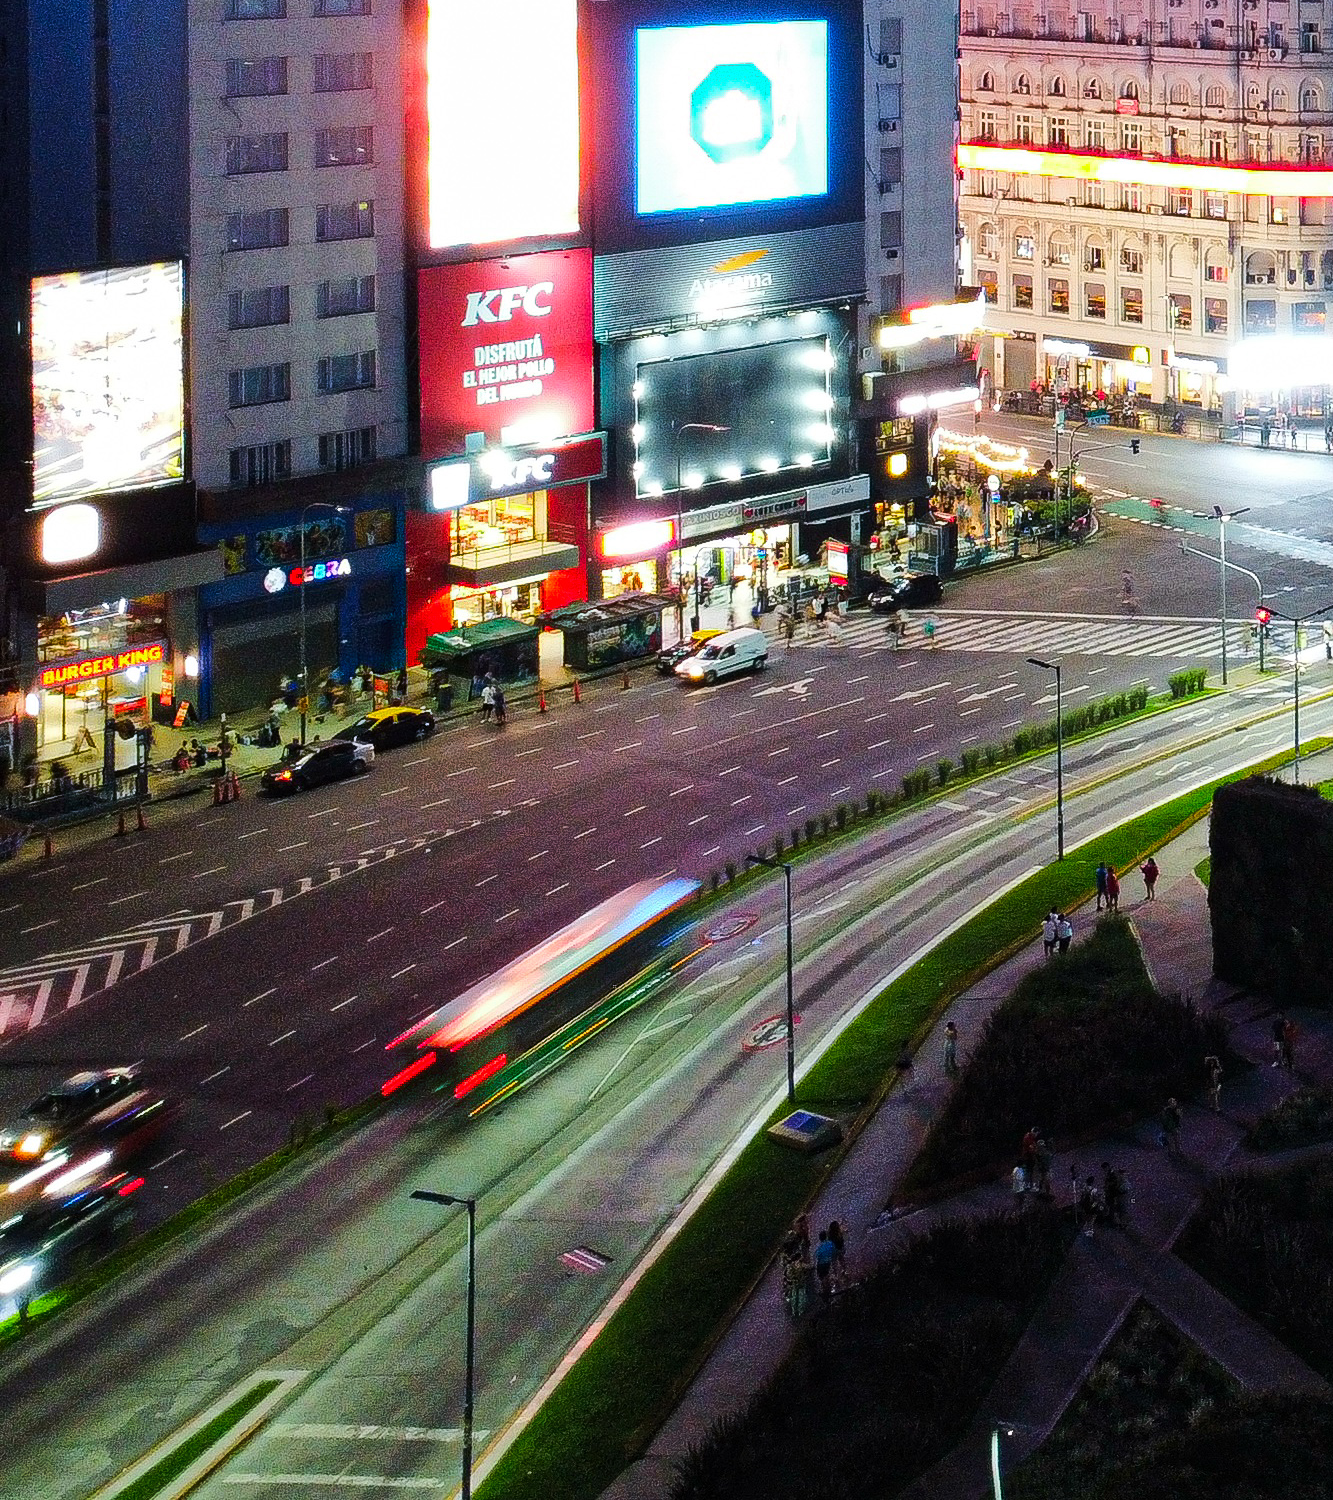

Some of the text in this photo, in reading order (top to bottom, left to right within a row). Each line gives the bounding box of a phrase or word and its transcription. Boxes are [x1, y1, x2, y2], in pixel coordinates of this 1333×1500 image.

[461, 281, 555, 327] KFC
[474, 333, 543, 367] DISFRUTÁ
[463, 357, 555, 388] EL MEJOR POLLO
[476, 387, 499, 406] DEL
[43, 645, 163, 685] BURGER KING
